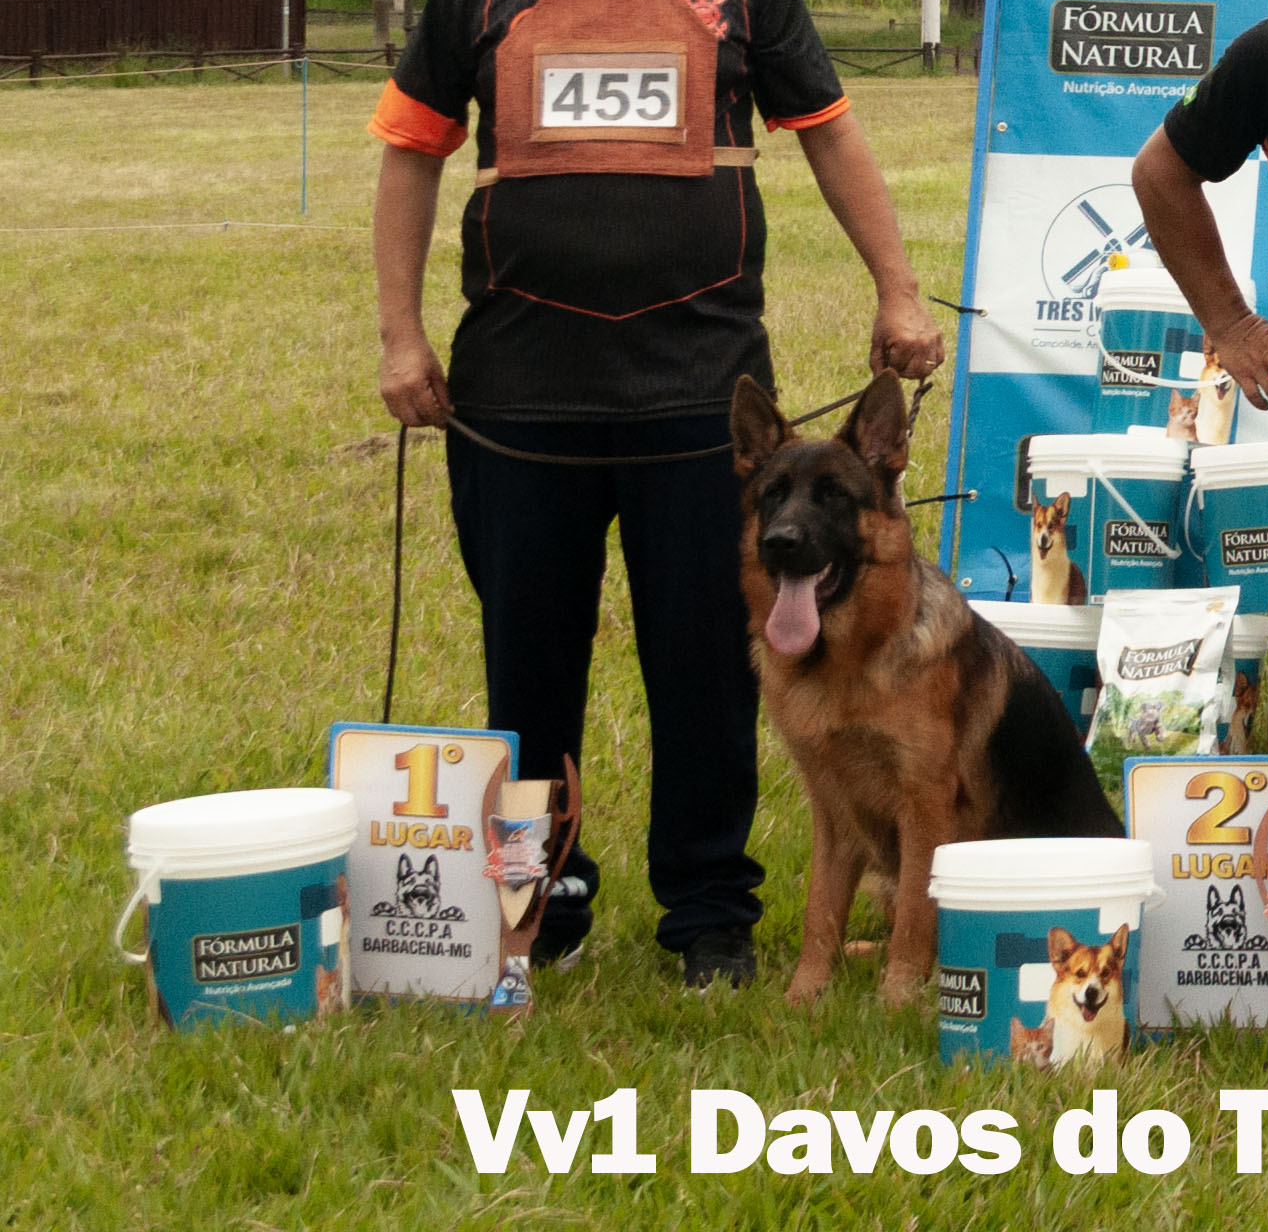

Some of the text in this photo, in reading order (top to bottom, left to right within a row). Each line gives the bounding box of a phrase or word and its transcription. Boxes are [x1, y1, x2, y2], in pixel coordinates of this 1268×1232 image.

[1063, 5, 1204, 34] FÓRMULA
[1061, 40, 1203, 69] NATURAL
[552, 72, 672, 121] 455
[1063, 81, 1123, 96] Nutrição
[1036, 297, 1084, 321] TRÊS
[1110, 539, 1166, 554] NATURA
[1125, 642, 1195, 663] FÓRMULA
[1121, 656, 1191, 678] NATURAL
[370, 820, 474, 851] LUGAR
[1172, 853, 1268, 879] LUGA
[386, 920, 453, 939] C.C.C.P.A
[200, 930, 294, 955] FÓRMULA
[362, 937, 472, 958] BARBACENA-MG
[201, 951, 296, 977] NATURAL
[1198, 953, 1260, 969] C.C.C.P.A
